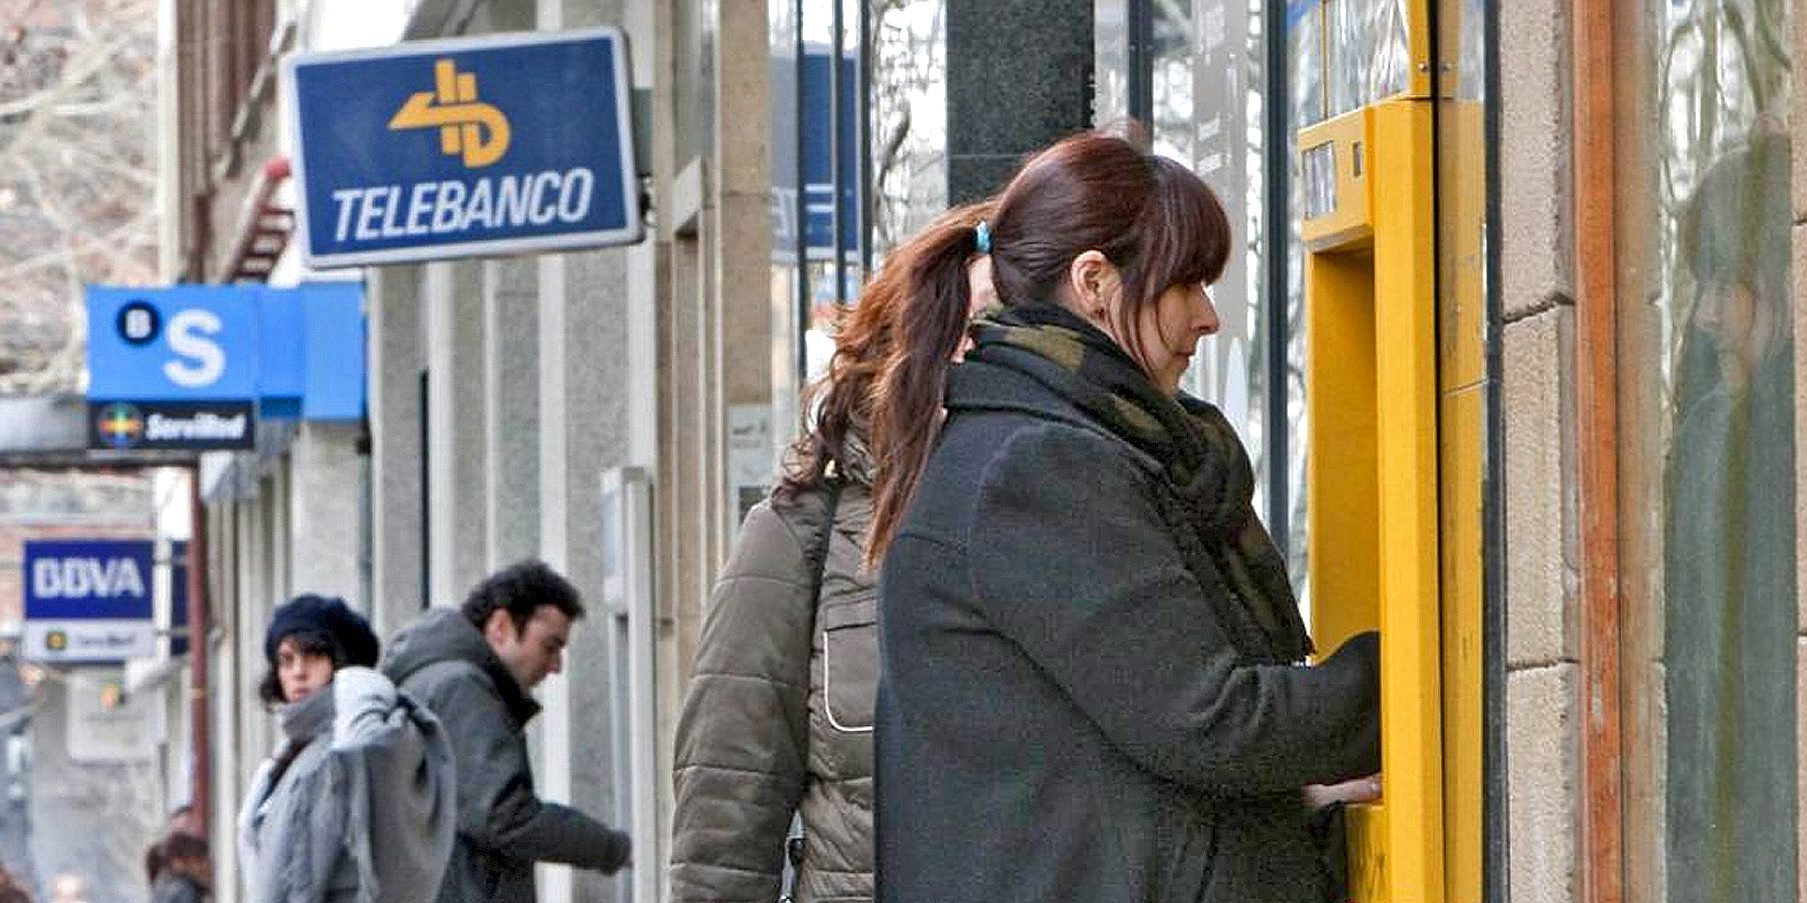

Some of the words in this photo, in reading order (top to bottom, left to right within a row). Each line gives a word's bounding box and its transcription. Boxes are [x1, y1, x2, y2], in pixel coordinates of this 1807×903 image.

[332, 168, 594, 242] TELEBANCO
[163, 309, 226, 387] S
[33, 557, 145, 598] BBVA
